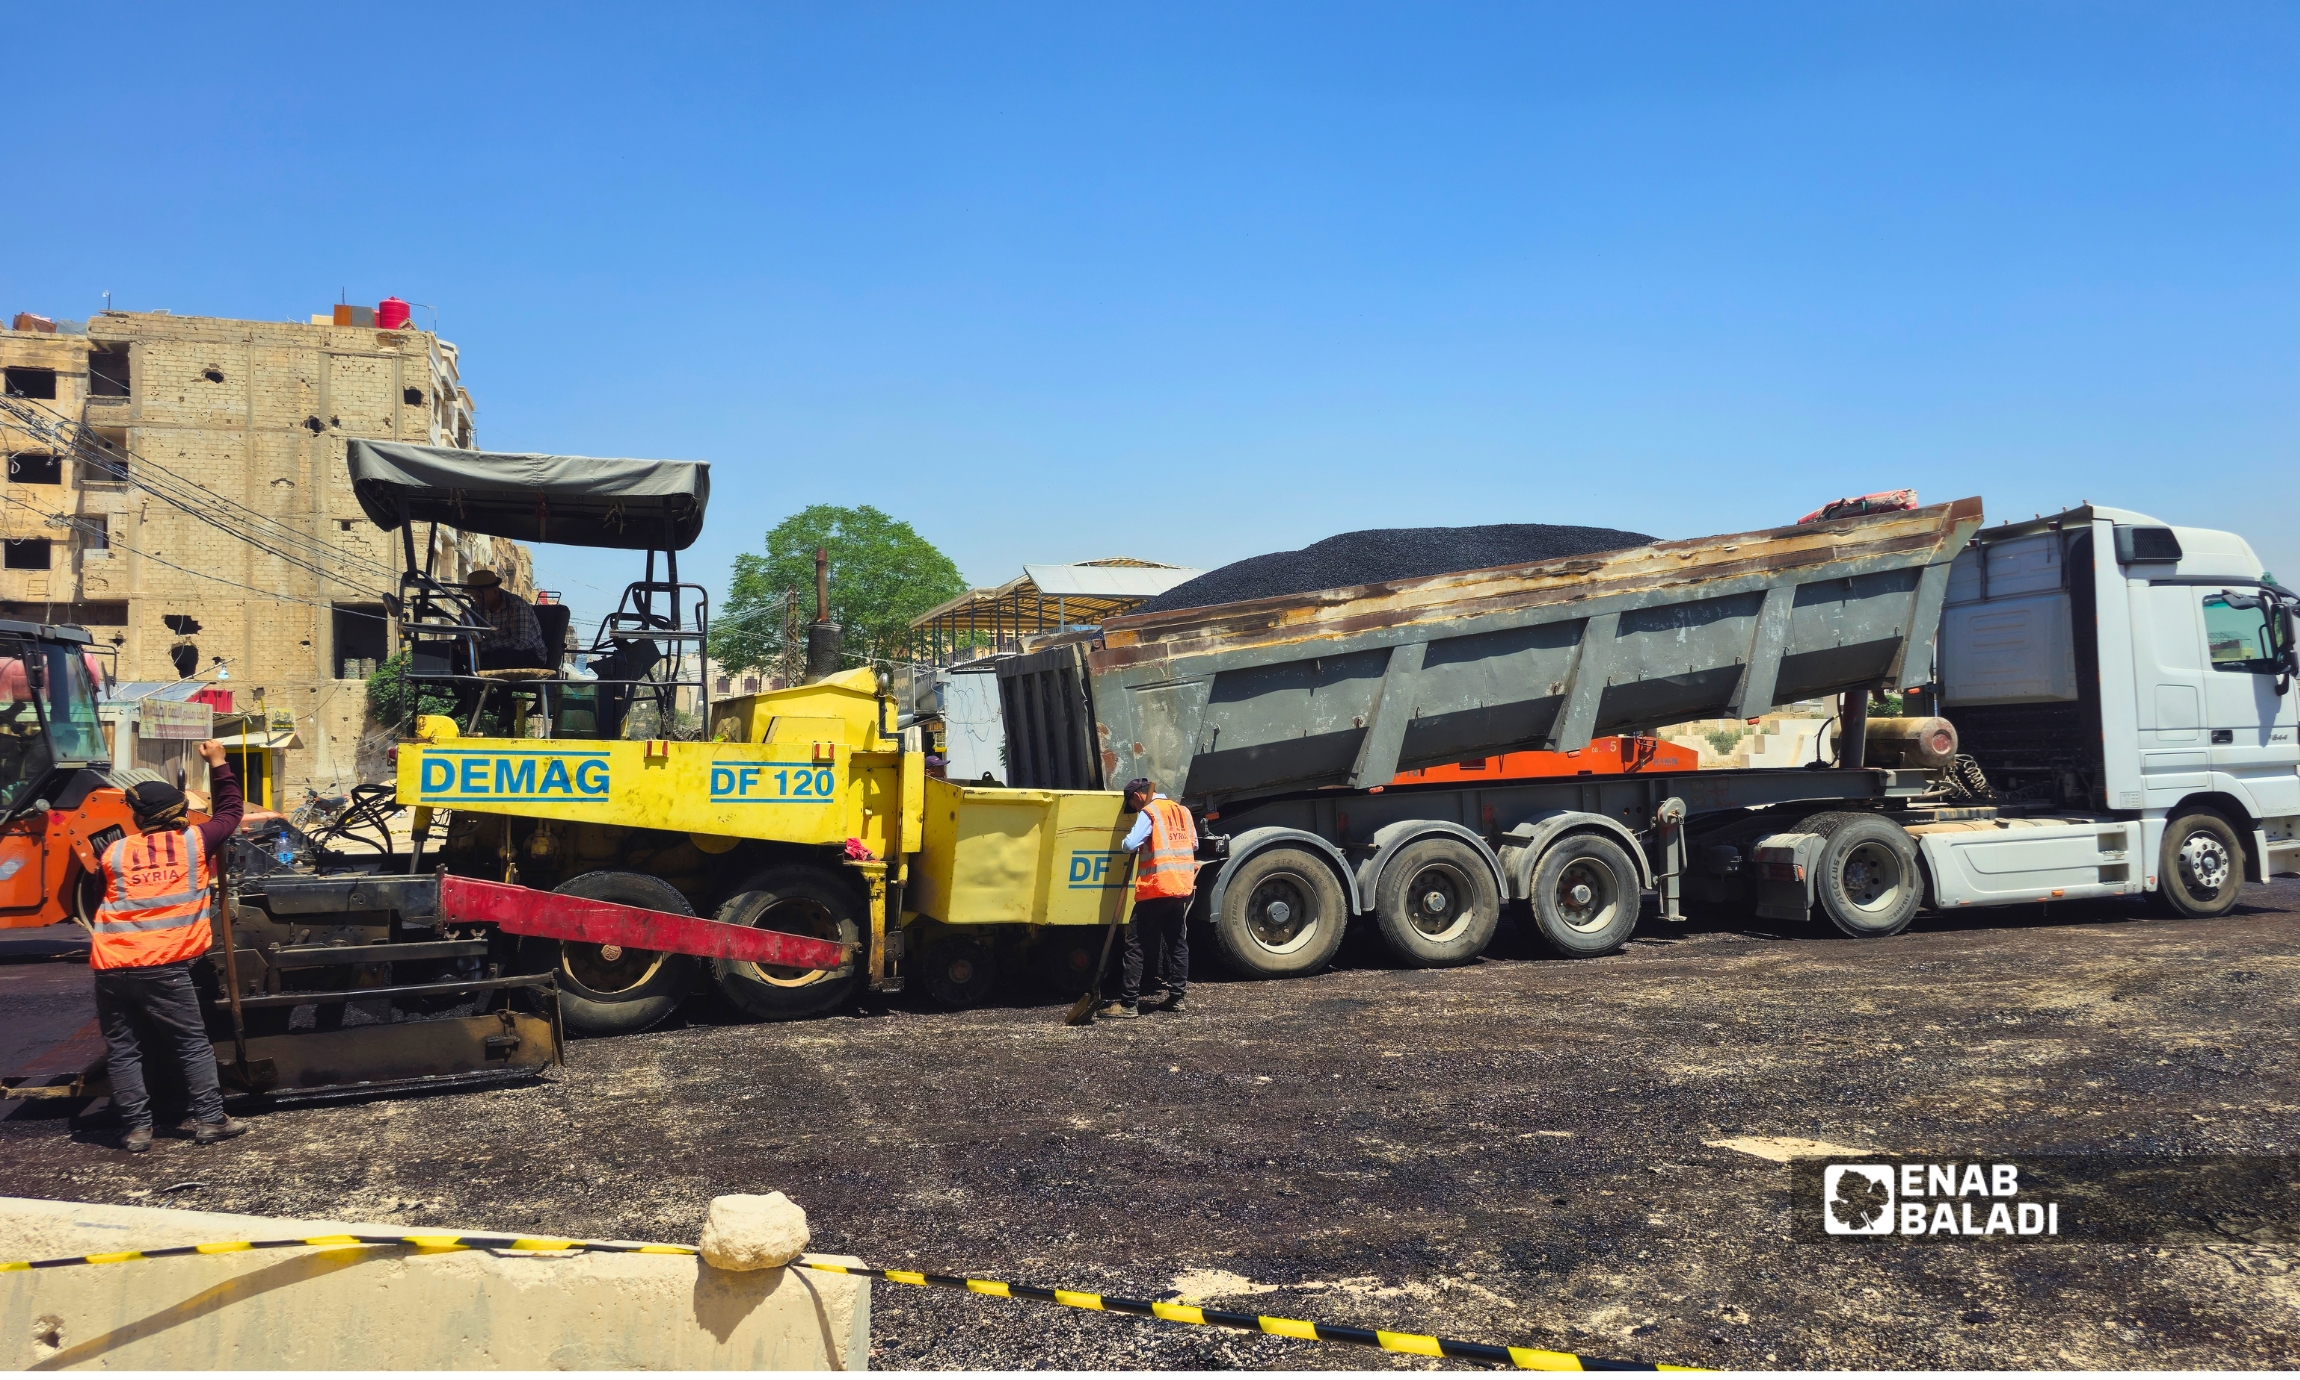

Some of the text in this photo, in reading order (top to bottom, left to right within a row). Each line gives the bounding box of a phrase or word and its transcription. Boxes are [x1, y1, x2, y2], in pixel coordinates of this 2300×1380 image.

[420, 758, 610, 795] DEMAG
[710, 768, 835, 797] DF 120
[131, 869, 180, 885] SYRIA
[1069, 856, 1112, 882] DF
[1832, 859, 1846, 906] AEOLUS
